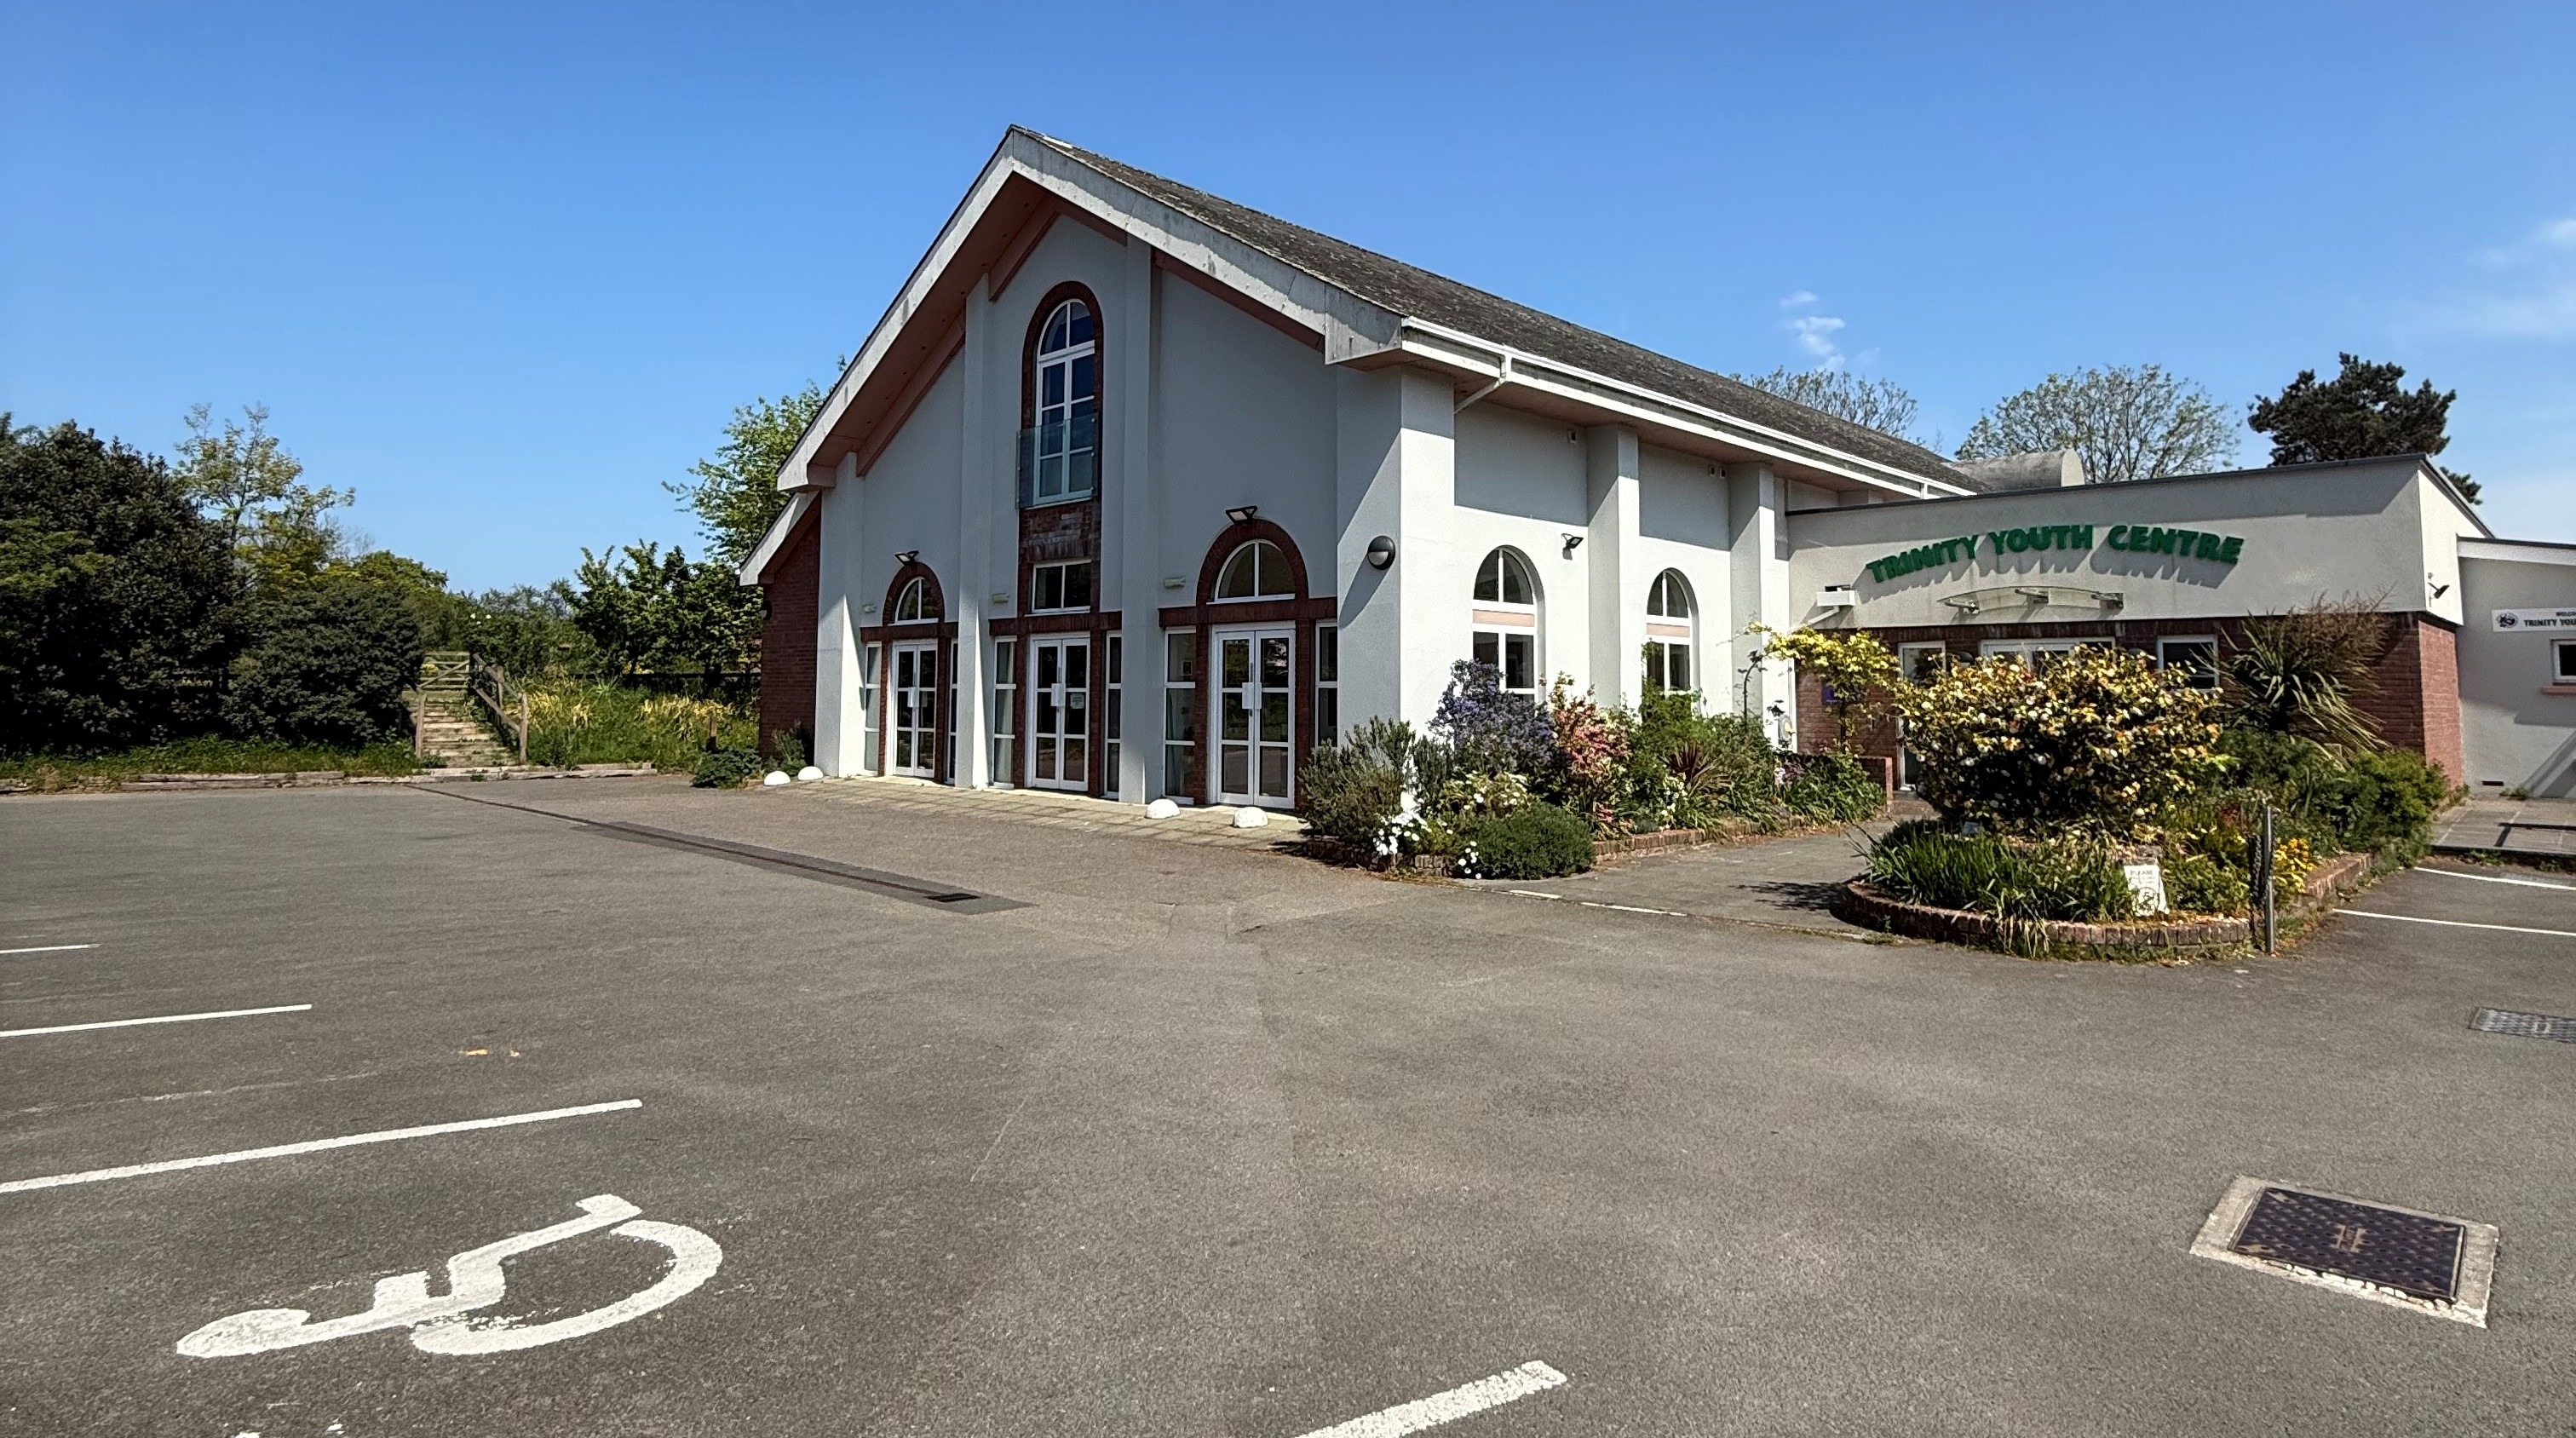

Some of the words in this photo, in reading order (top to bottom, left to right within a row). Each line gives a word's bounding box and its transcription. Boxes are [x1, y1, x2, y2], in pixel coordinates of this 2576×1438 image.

[1866, 534, 1979, 584] TRINITY
[1987, 525, 2094, 555] YOUTH
[2108, 525, 2245, 565] CENTRE
[2524, 618, 2557, 627] TRINITY
